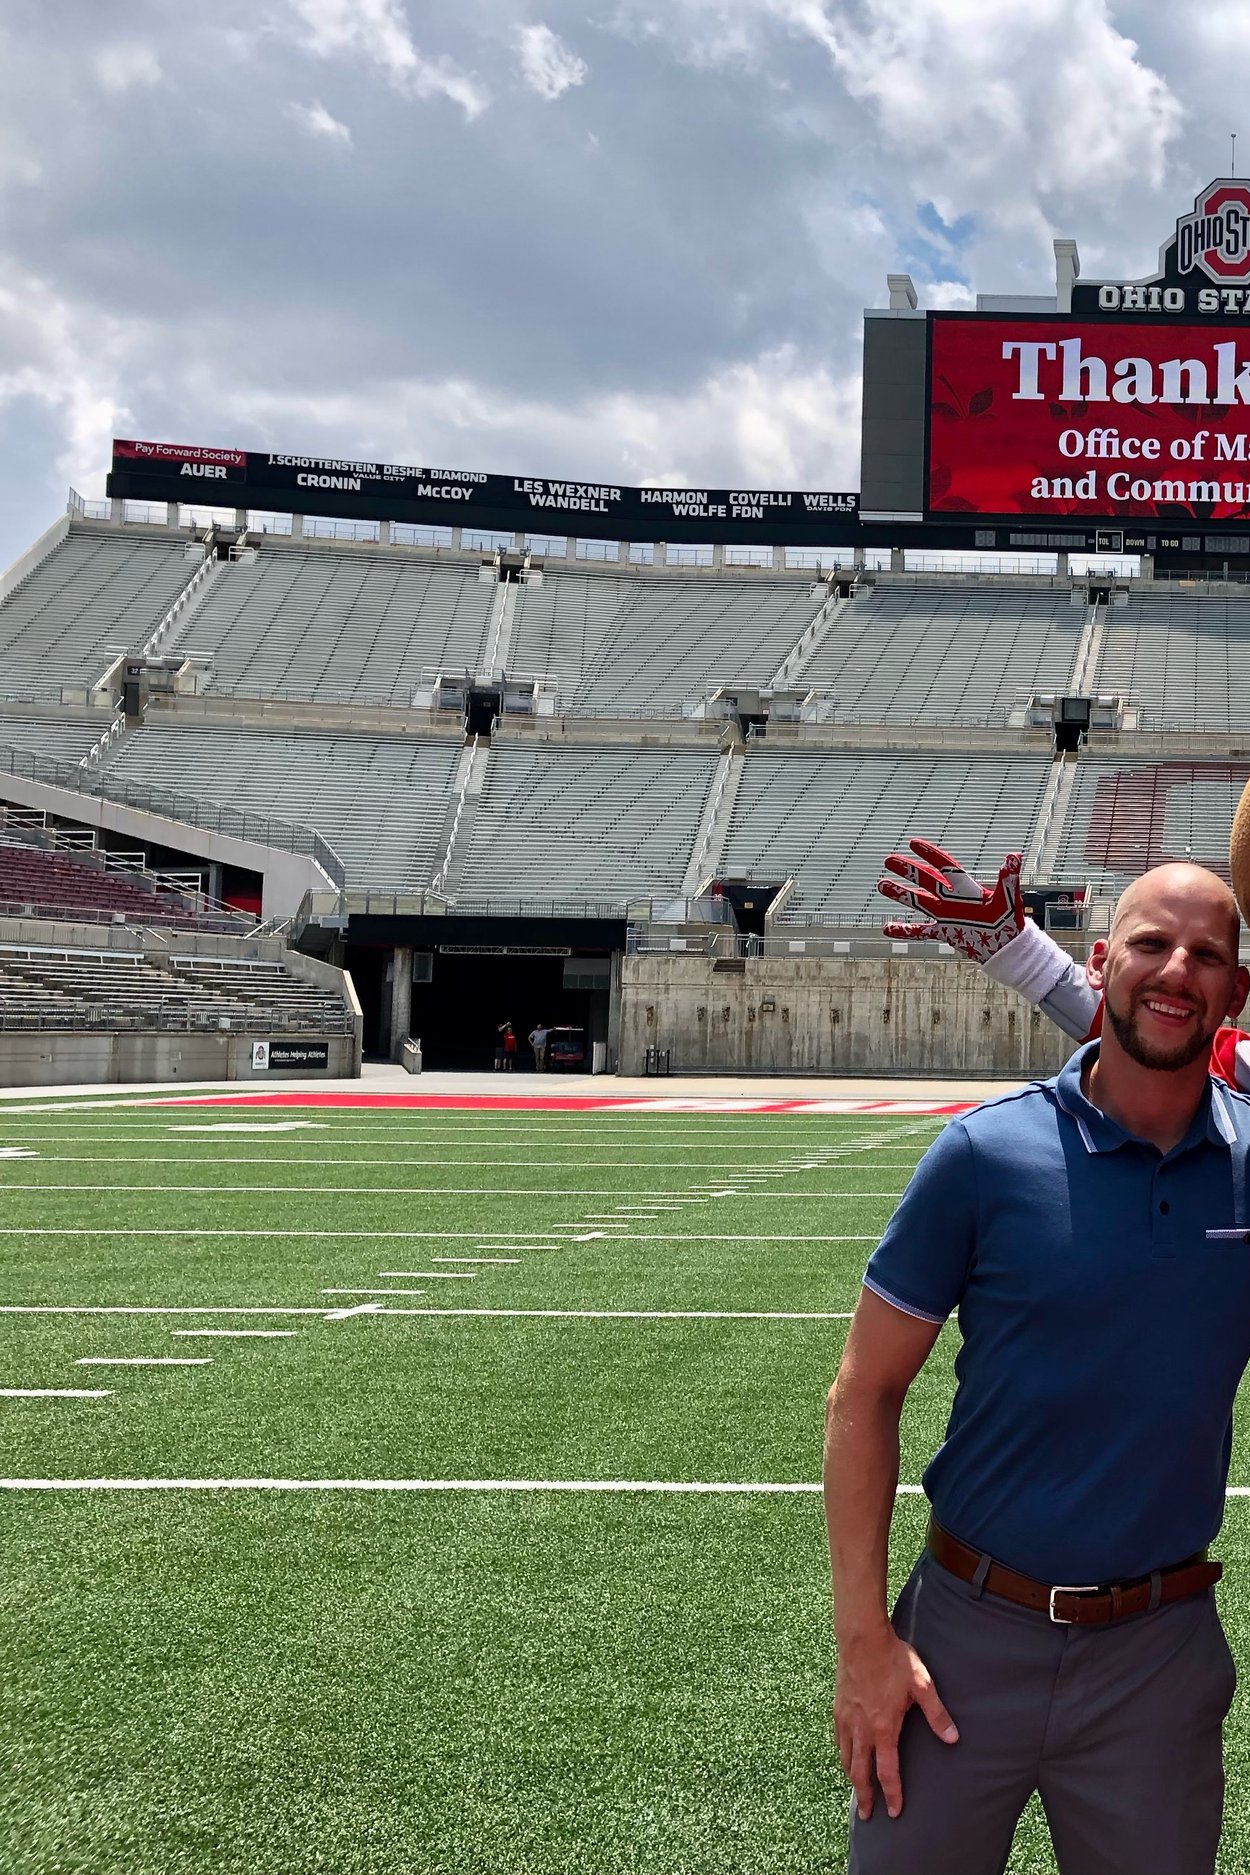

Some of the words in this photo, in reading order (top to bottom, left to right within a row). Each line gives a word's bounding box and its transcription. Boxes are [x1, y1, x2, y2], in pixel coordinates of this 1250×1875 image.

[1098, 285, 1186, 313] OHIO
[135, 443, 154, 454] Pay
[156, 445, 199, 459] Forward
[201, 448, 242, 463] Society
[1057, 429, 1162, 460] Office
[1169, 431, 1210, 461] of
[180, 463, 227, 479] AUER
[383, 464, 426, 479] DESHE,
[430, 470, 488, 484] DIAMOND
[296, 473, 362, 492] CRONIN
[513, 479, 544, 494] LES
[548, 482, 621, 501] WEXNER
[1029, 469, 1098, 502] and
[417, 483, 473, 501] McCOY
[640, 490, 708, 505] HARMON
[729, 492, 792, 507] COVELLI
[803, 493, 856, 508] WELLS
[529, 493, 609, 513] WANDELL
[672, 503, 727, 517] WOLFE
[731, 504, 764, 519] FDN
[1125, 538, 1145, 547] DOWN
[1161, 539, 1170, 547] TO
[1172, 540, 1179, 548] GO
[271, 1050, 289, 1058] Athletes
[290, 1050, 306, 1060] Helping
